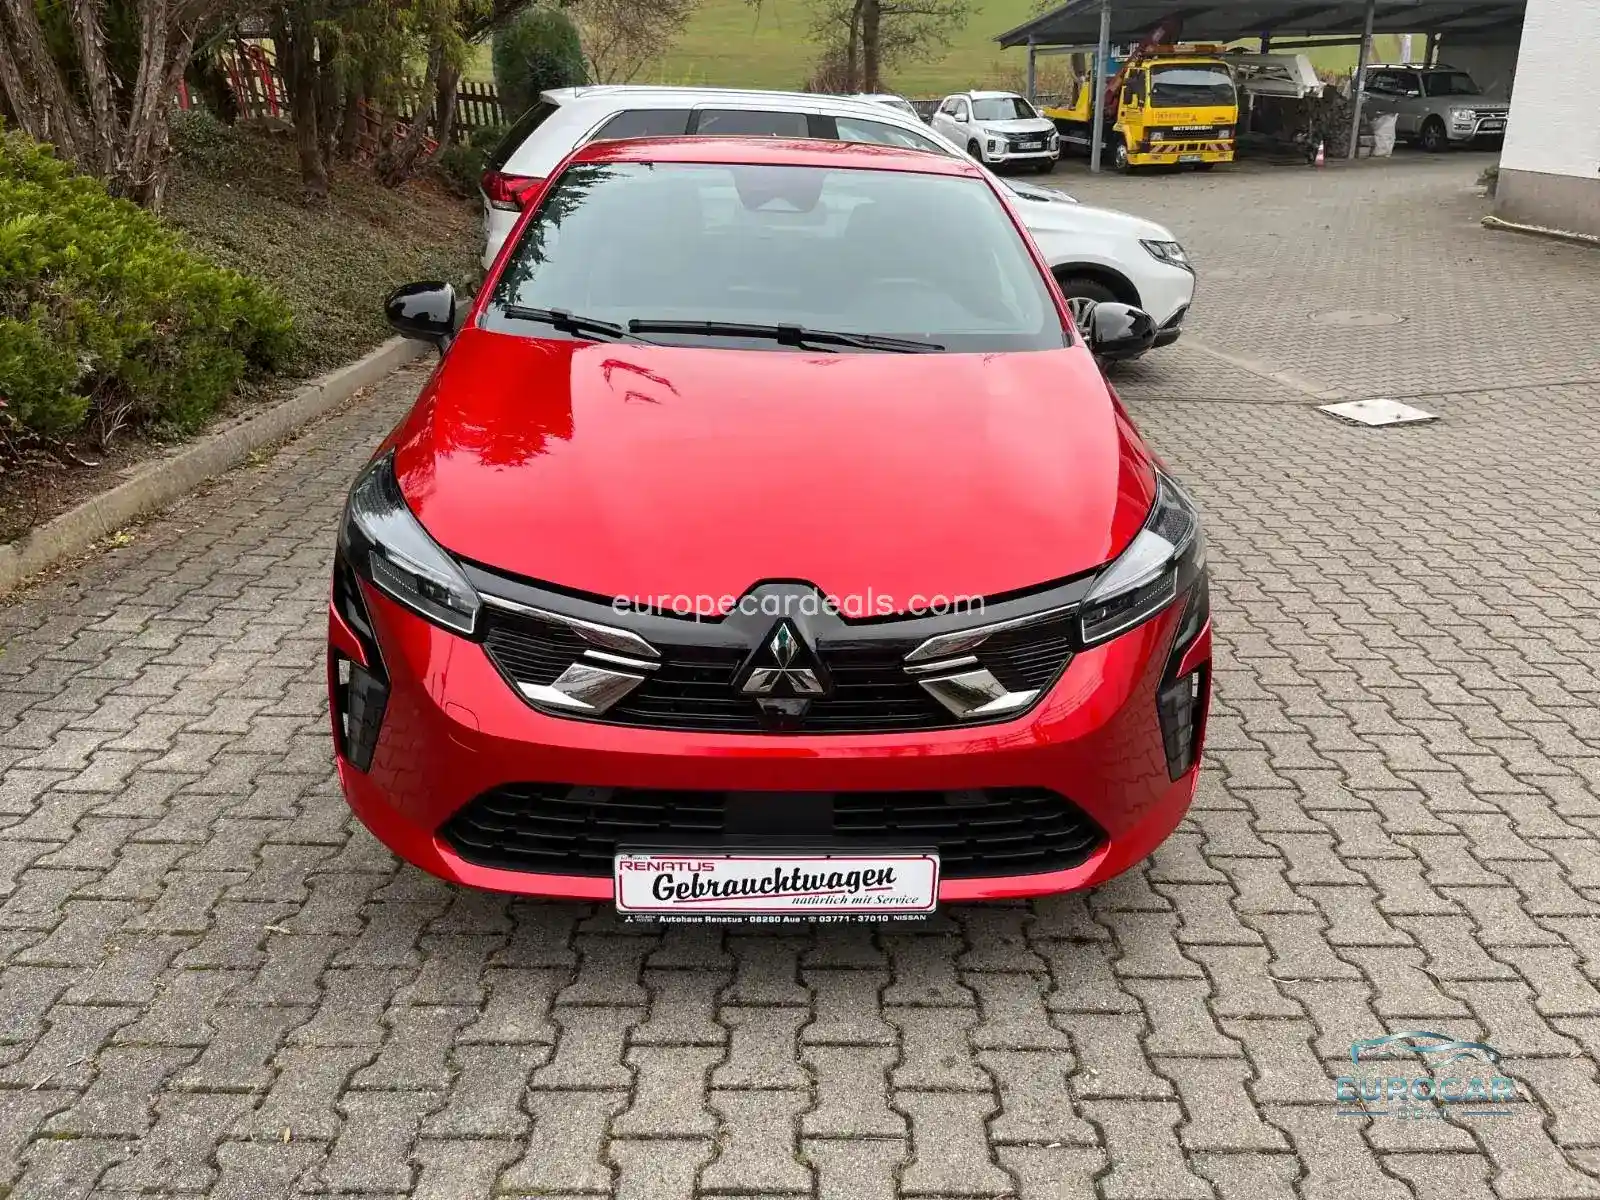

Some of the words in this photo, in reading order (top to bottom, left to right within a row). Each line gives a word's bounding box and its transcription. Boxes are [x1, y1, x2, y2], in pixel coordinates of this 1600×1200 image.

[619, 861, 715, 872] RENATUS
[652, 867, 897, 901] Gebrauchtwagen
[791, 894, 848, 905] natürlich
[850, 894, 873, 905] mit
[874, 893, 919, 905] Service
